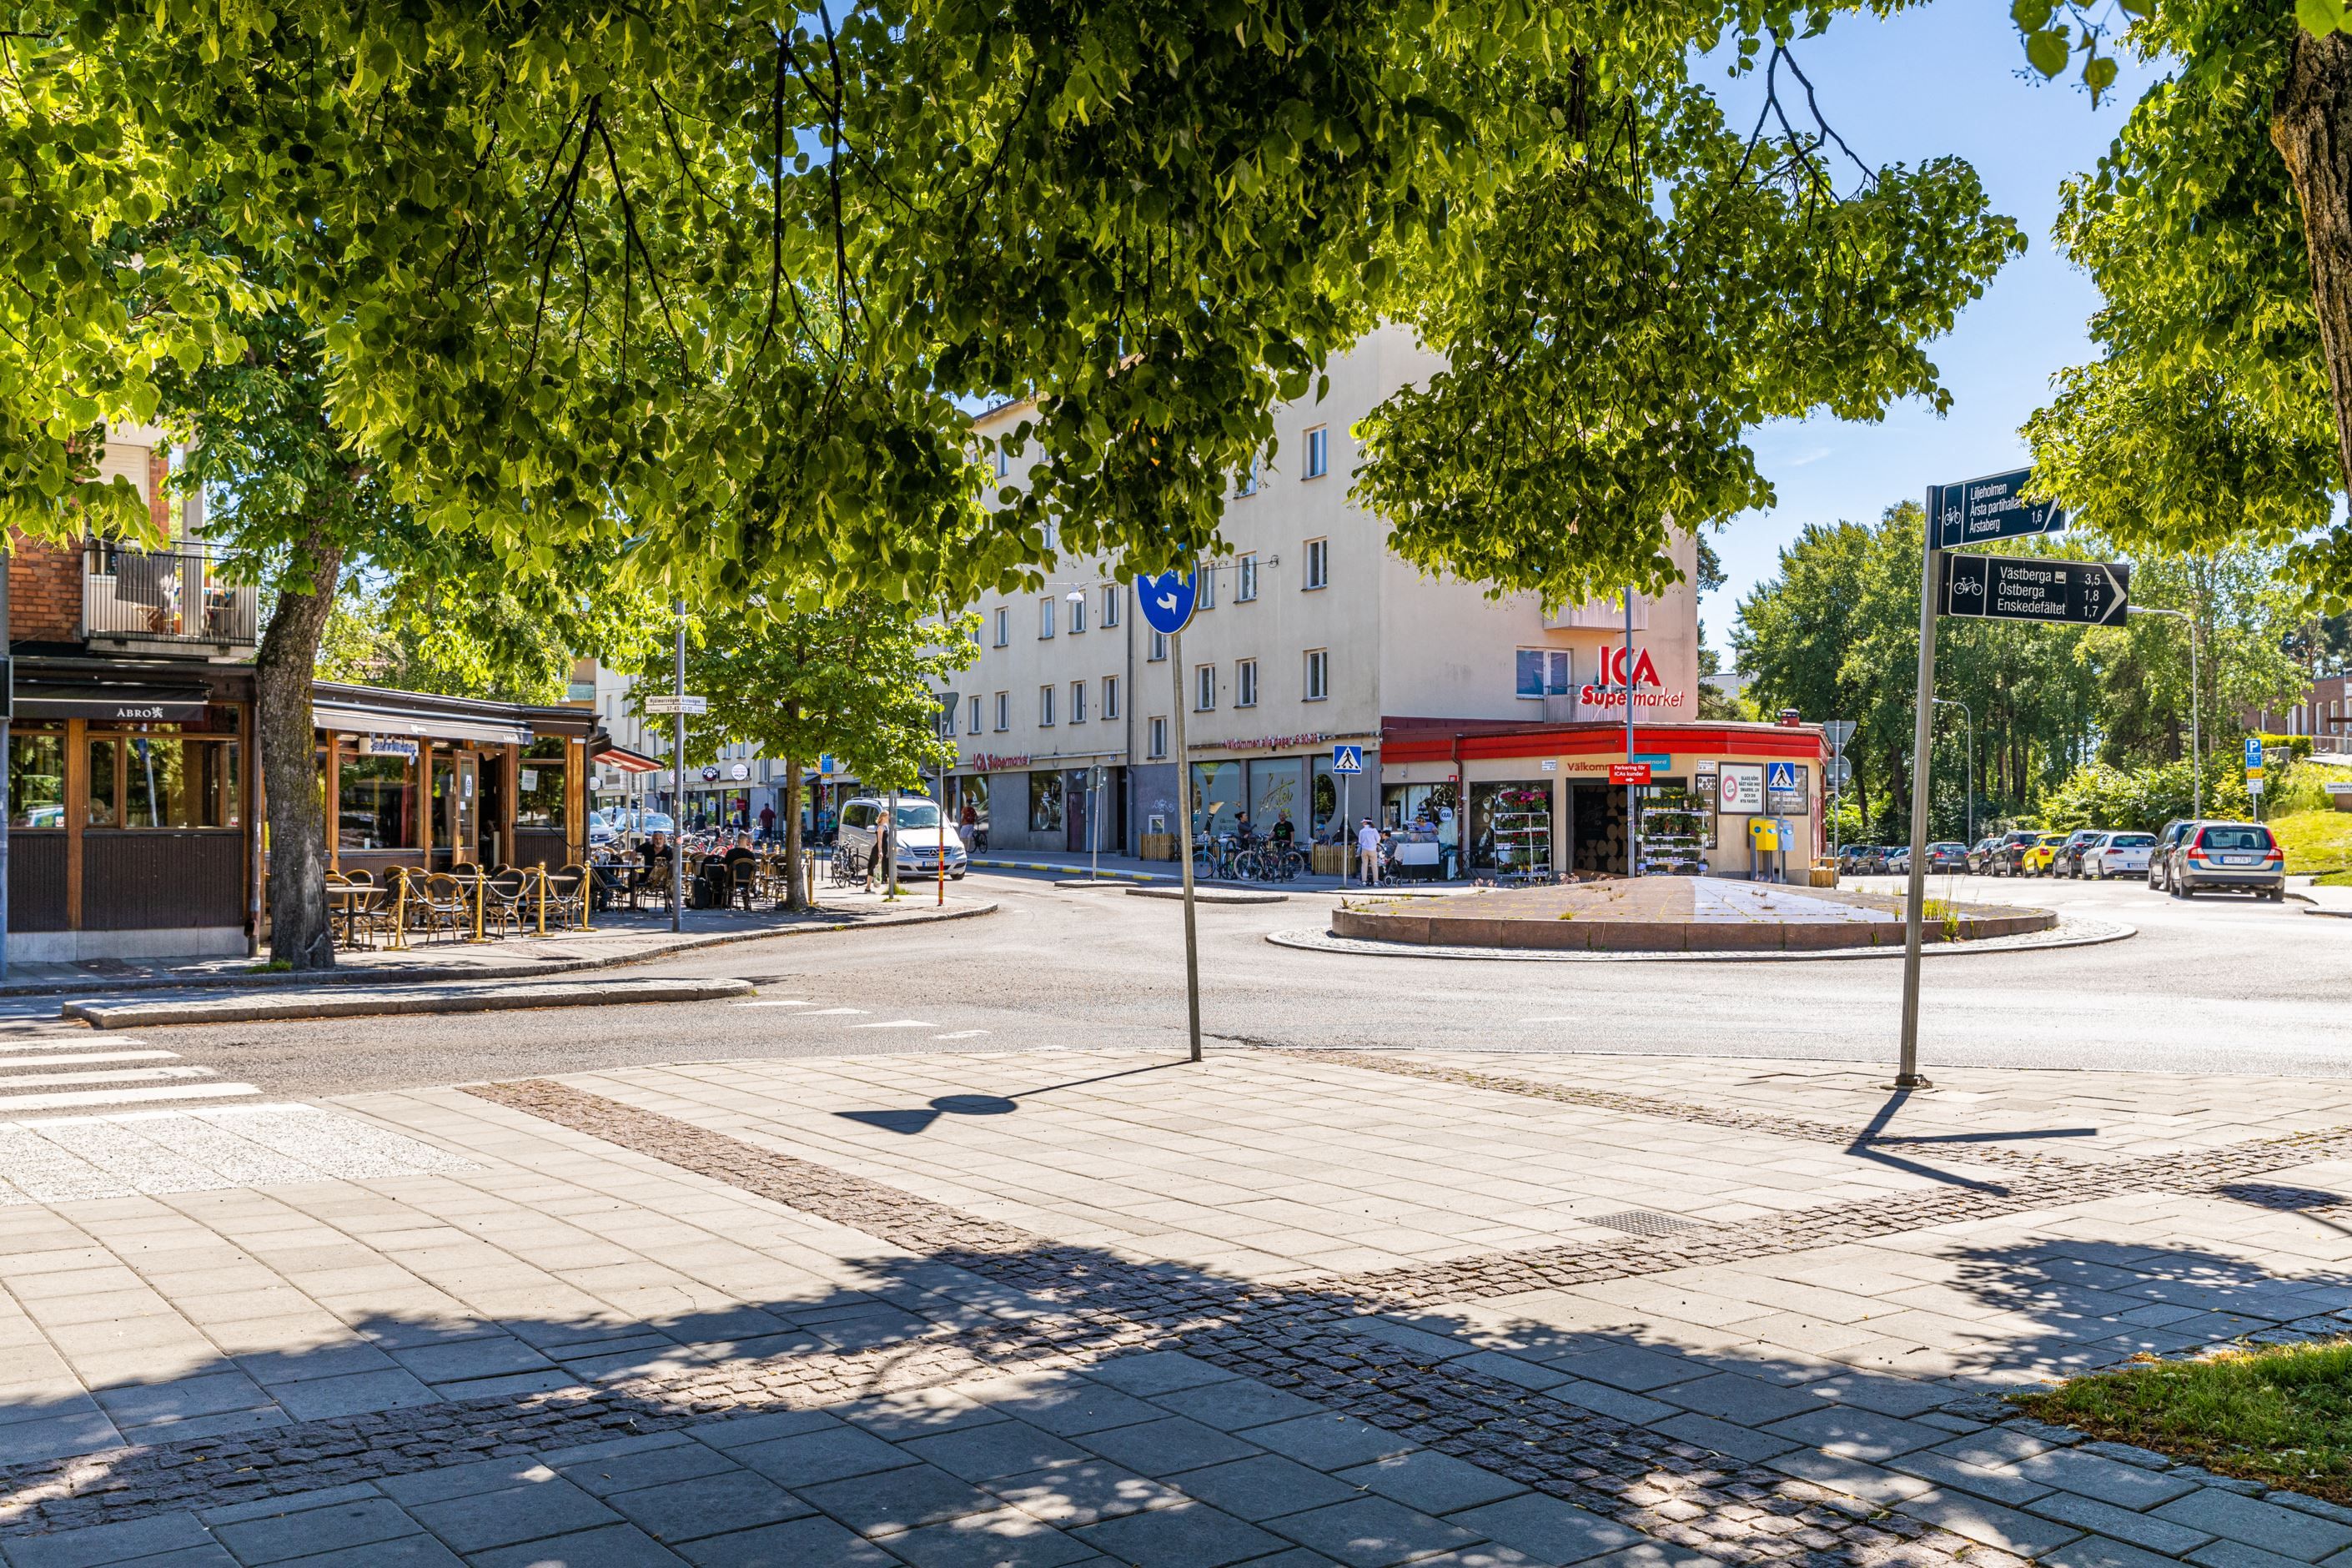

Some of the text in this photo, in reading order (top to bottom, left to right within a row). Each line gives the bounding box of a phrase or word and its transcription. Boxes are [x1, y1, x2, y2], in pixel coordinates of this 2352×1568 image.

[1970, 483, 2008, 502] Liljeholmen
[1970, 502, 1987, 517] Årsta
[1969, 510, 2043, 534] Årstaberg 1,6
[2000, 566, 2100, 586] Västberga 3,5
[1998, 580, 2099, 602] Östberga 1,8
[1998, 599, 2098, 619] Enskedefältet 1,7
[1599, 646, 1661, 686] ICA
[1581, 685, 1684, 709] Supemarket
[1224, 737, 1260, 750] Välkommen
[1261, 736, 1272, 747] alla
[1274, 733, 1292, 749] dagar
[2249, 741, 2259, 752] P
[973, 751, 1031, 771] ICA Supermarket
